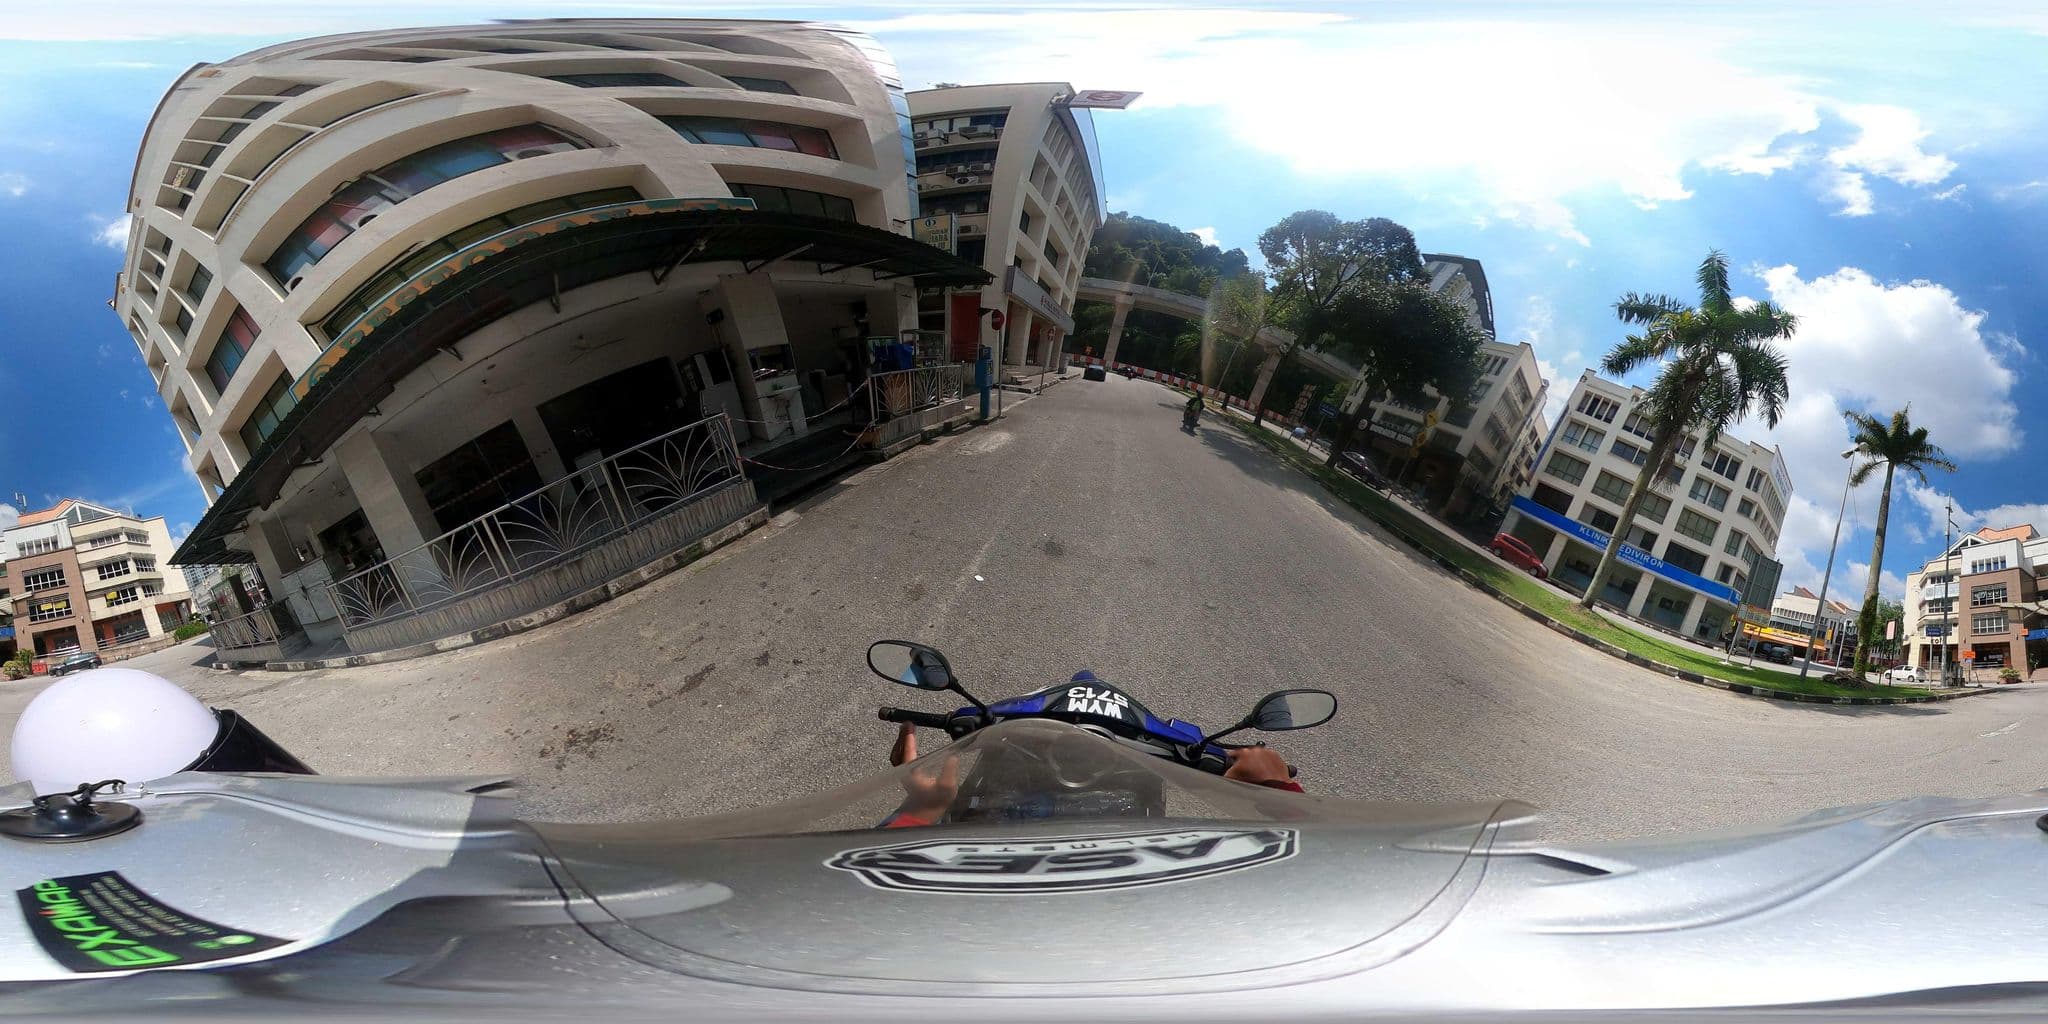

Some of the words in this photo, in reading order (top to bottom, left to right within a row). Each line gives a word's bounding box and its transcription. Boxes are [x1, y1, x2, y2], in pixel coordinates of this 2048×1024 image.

[1578, 526, 1610, 544] KLINIK
[1618, 544, 1665, 569] EDIVIRON
[1067, 686, 1129, 709] 5713
[1067, 697, 1122, 720] WYM
[956, 833, 1200, 854] HELMETS
[33, 879, 183, 967] EXAMAP
